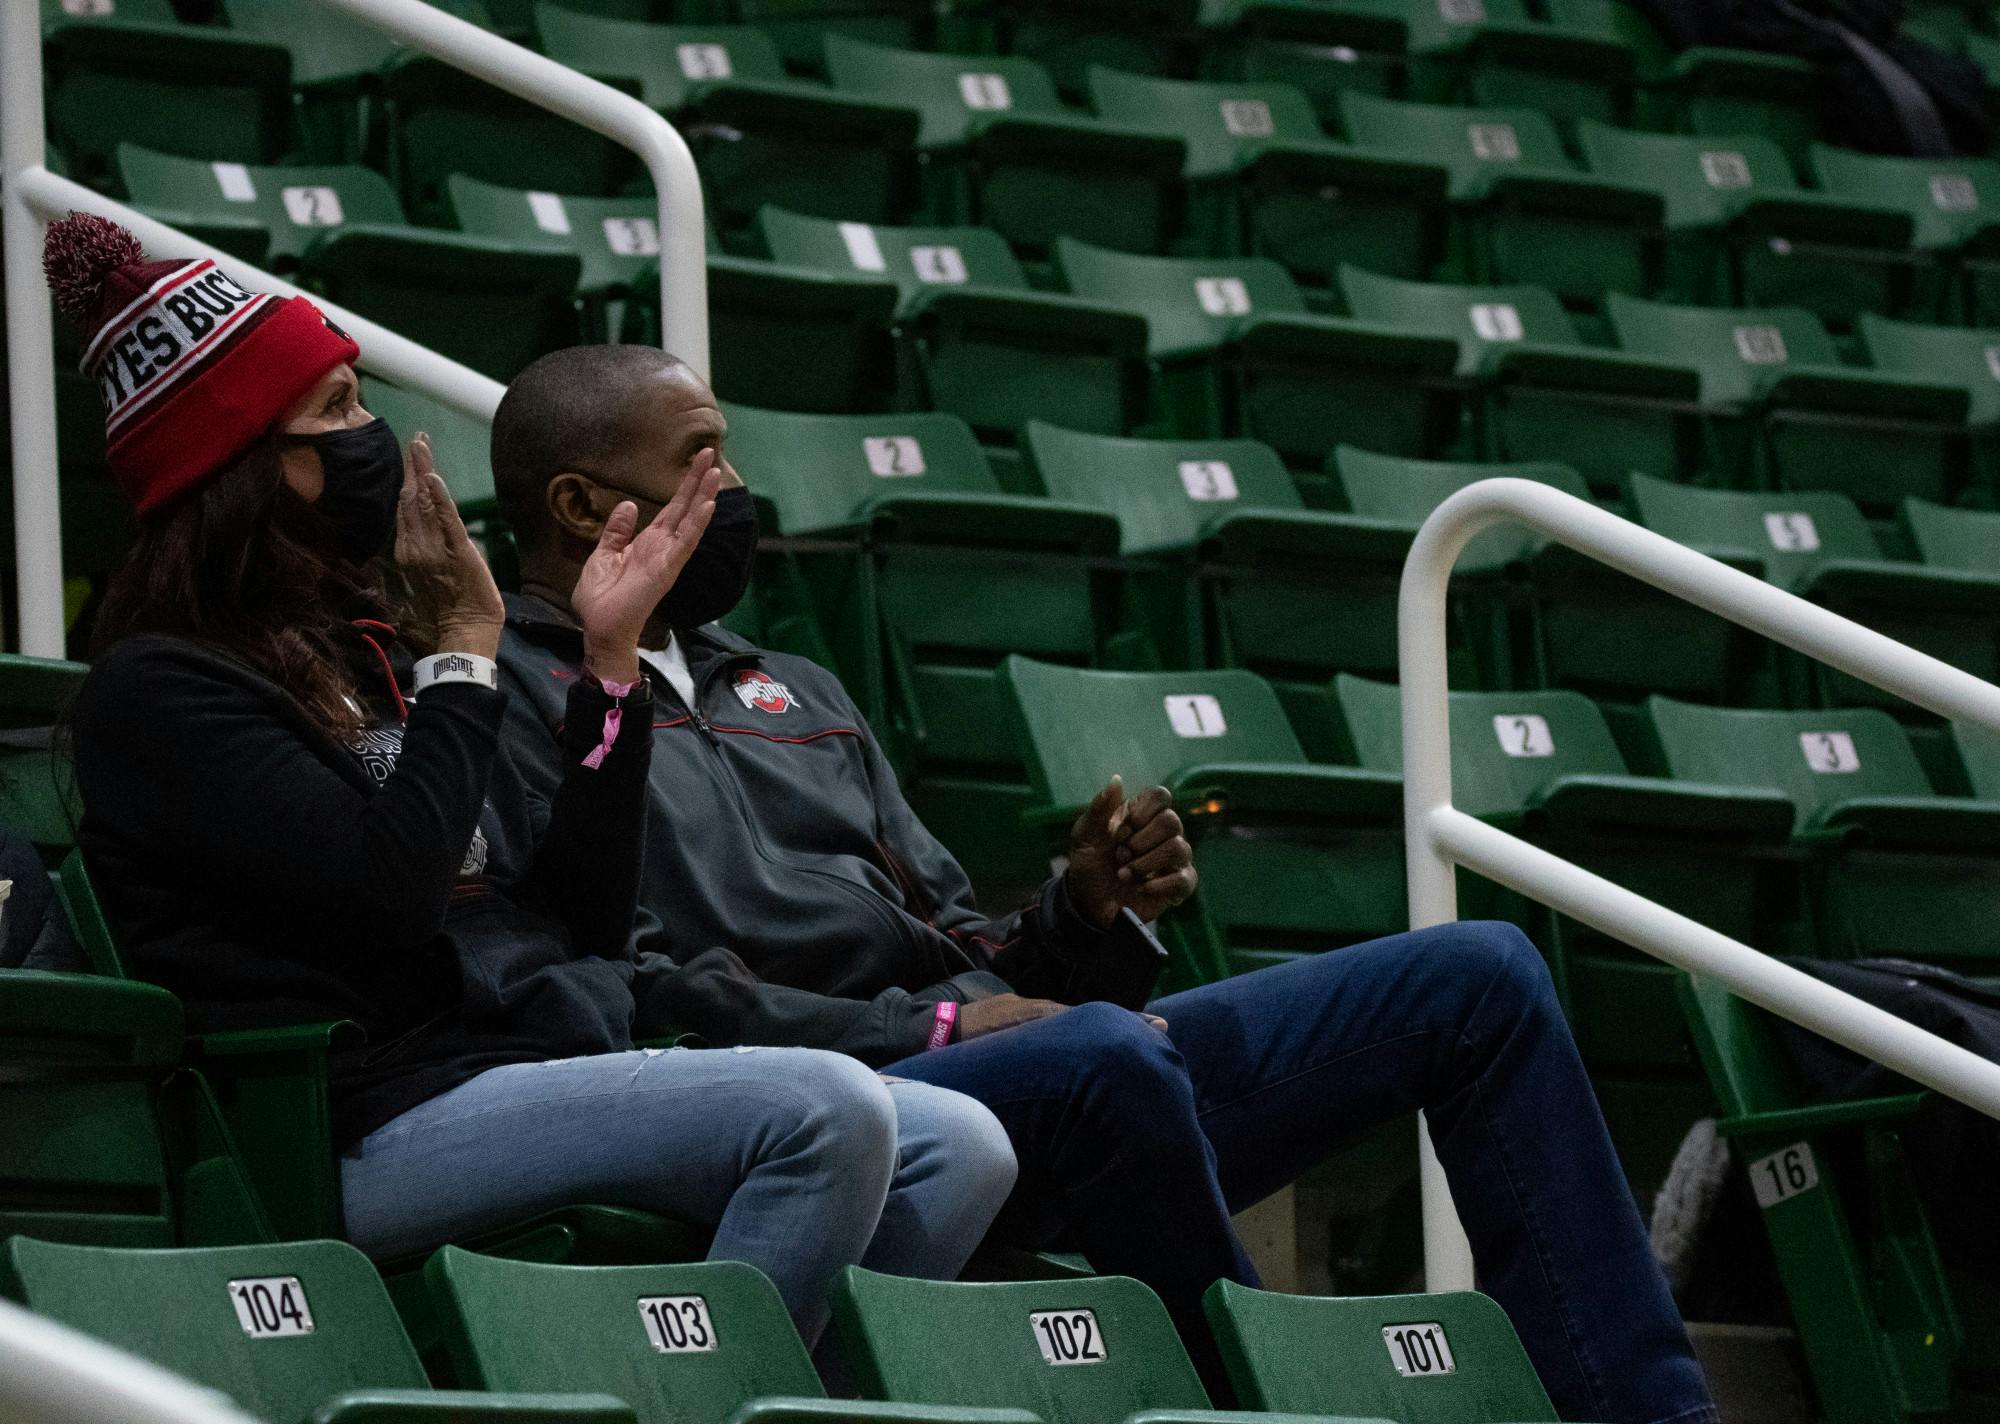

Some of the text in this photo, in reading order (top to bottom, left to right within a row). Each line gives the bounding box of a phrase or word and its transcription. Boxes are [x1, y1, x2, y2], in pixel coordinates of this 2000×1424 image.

[302, 188, 322, 224] 2
[102, 316, 181, 414] YES
[884, 438, 903, 473] 2
[1199, 461, 1219, 497] 3
[1189, 700, 1204, 733] 1
[1515, 719, 1535, 752] 2
[1821, 734, 1841, 768] 3
[1766, 1150, 1806, 1196] 16
[238, 1283, 302, 1332] 104
[647, 1302, 708, 1348] 103
[1040, 1315, 1100, 1360] 102
[1394, 1329, 1446, 1373] 101
